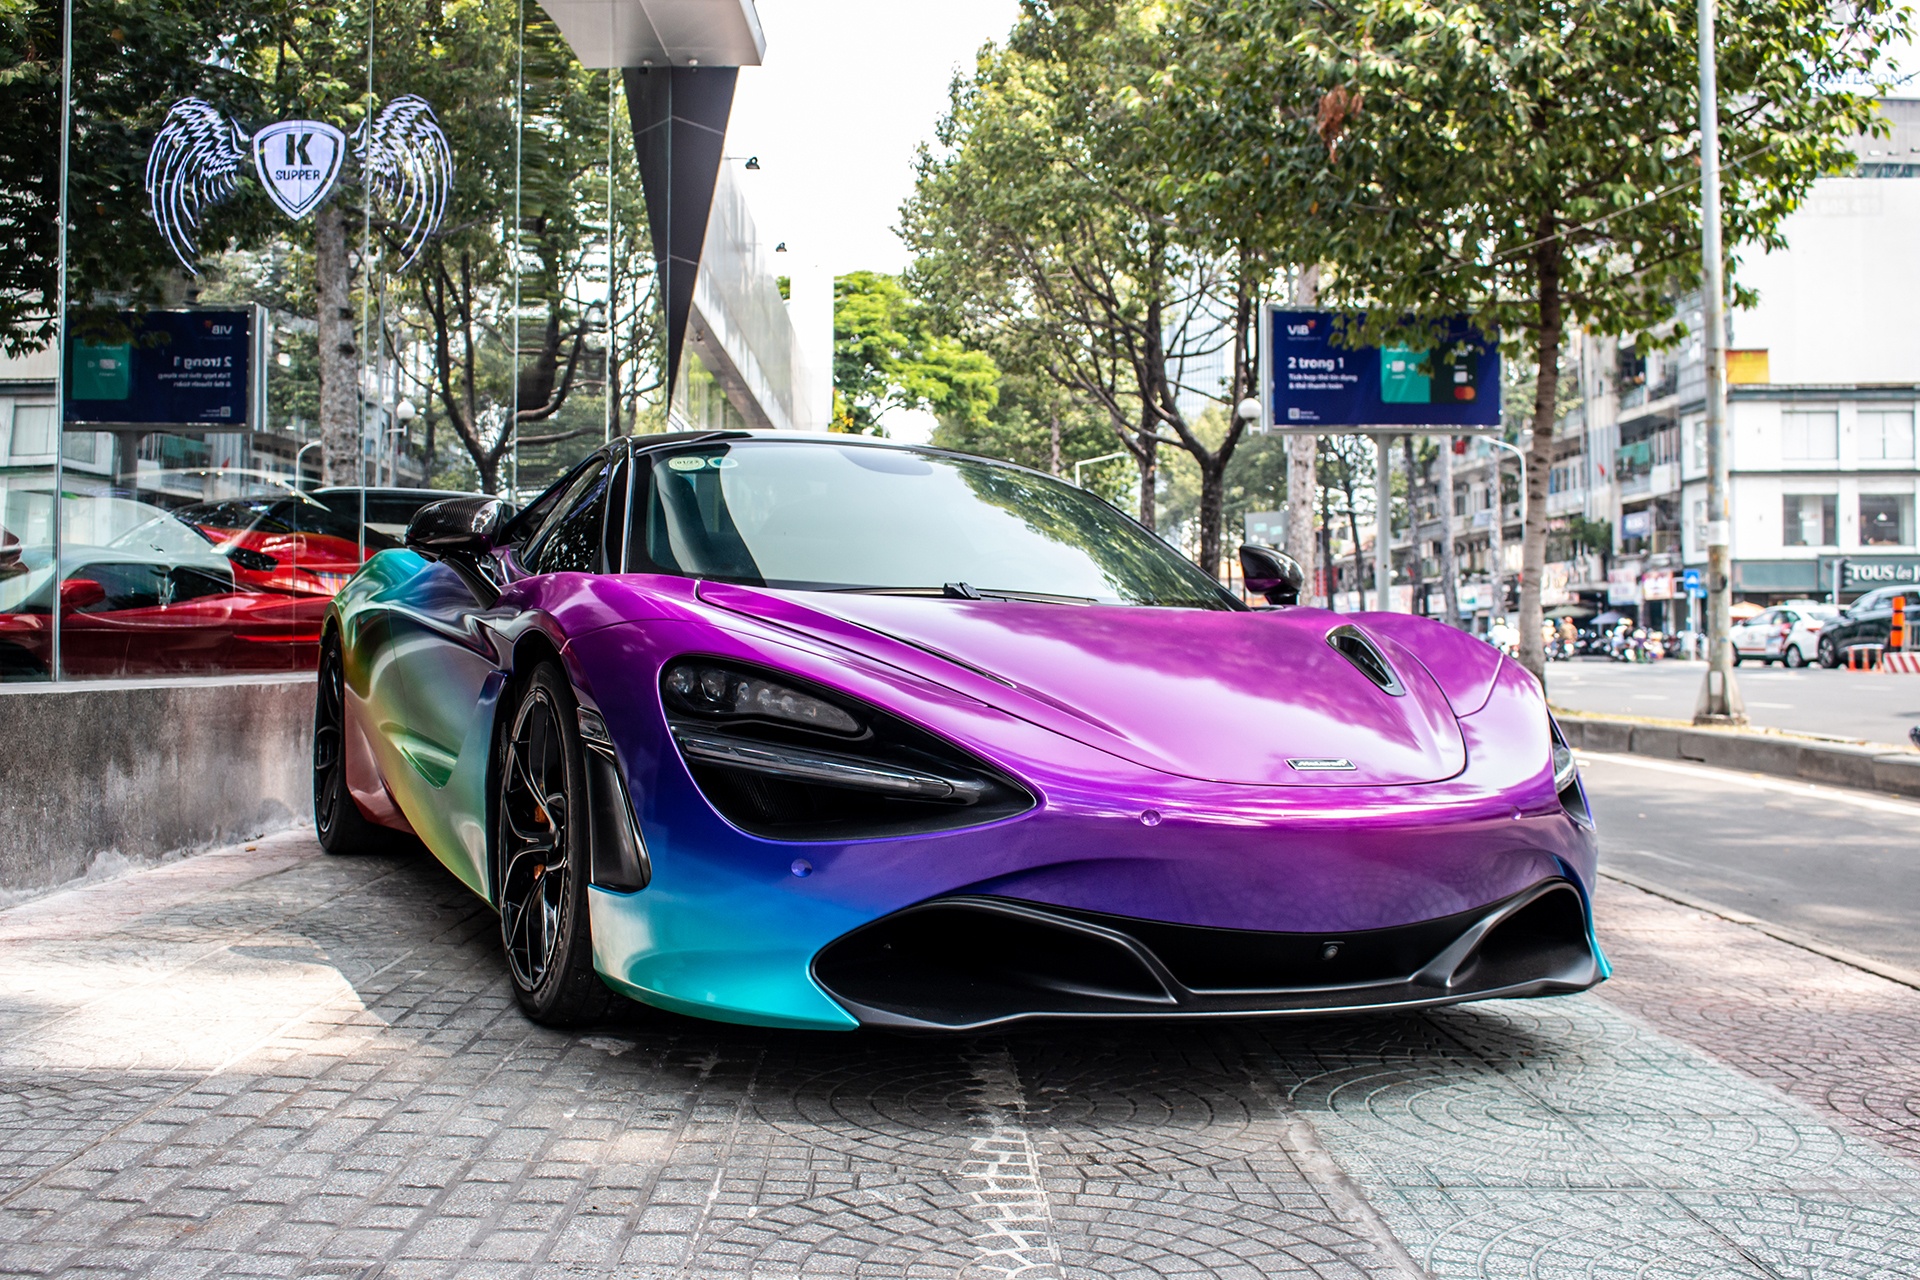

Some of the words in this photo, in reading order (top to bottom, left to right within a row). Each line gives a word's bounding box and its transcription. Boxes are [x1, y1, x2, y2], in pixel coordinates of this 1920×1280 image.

[286, 133, 314, 166] K
[275, 169, 321, 180] SUPPER
[1287, 325, 1309, 335] VIB
[1287, 356, 1297, 369] 2
[1298, 356, 1335, 372] trong
[1337, 356, 1344, 369] 1
[1851, 564, 1894, 580] TOUS
